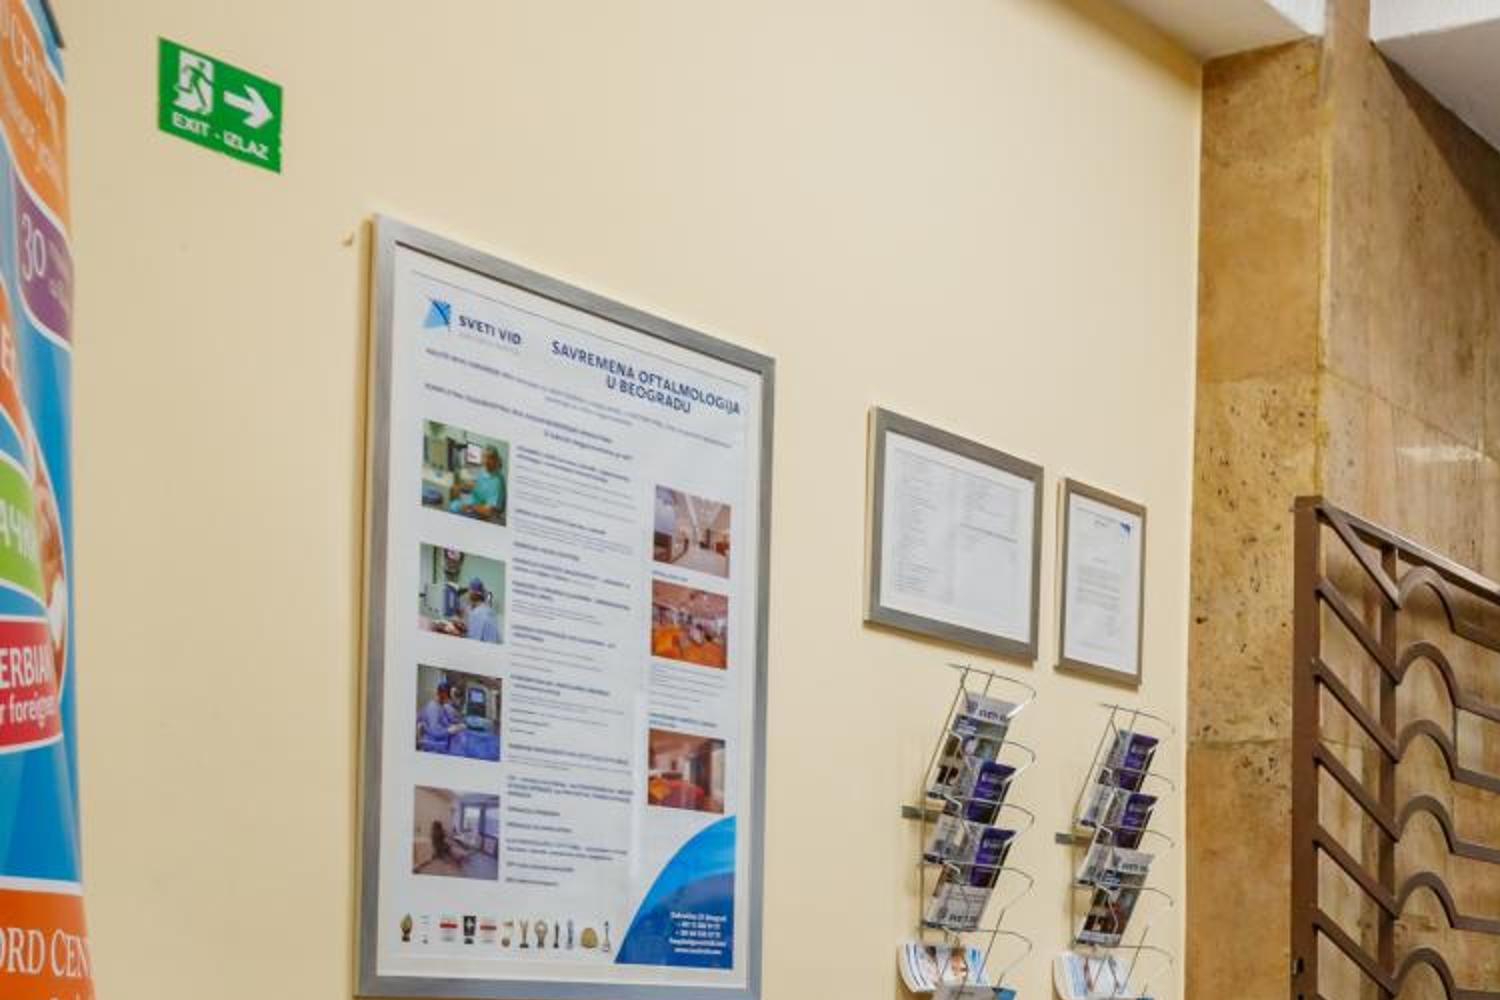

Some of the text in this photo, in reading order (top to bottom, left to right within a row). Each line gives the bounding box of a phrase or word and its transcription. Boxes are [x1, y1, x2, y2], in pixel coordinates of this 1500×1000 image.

[172, 111, 210, 138] EXIT
[223, 130, 269, 161] IZLAZ
[21, 212, 46, 282] 30
[458, 314, 522, 346] SVETI VID
[551, 340, 635, 381] SAVREMENA
[637, 369, 741, 416] OFTALMOLOGIJA
[606, 374, 692, 414] U BEOGRADU
